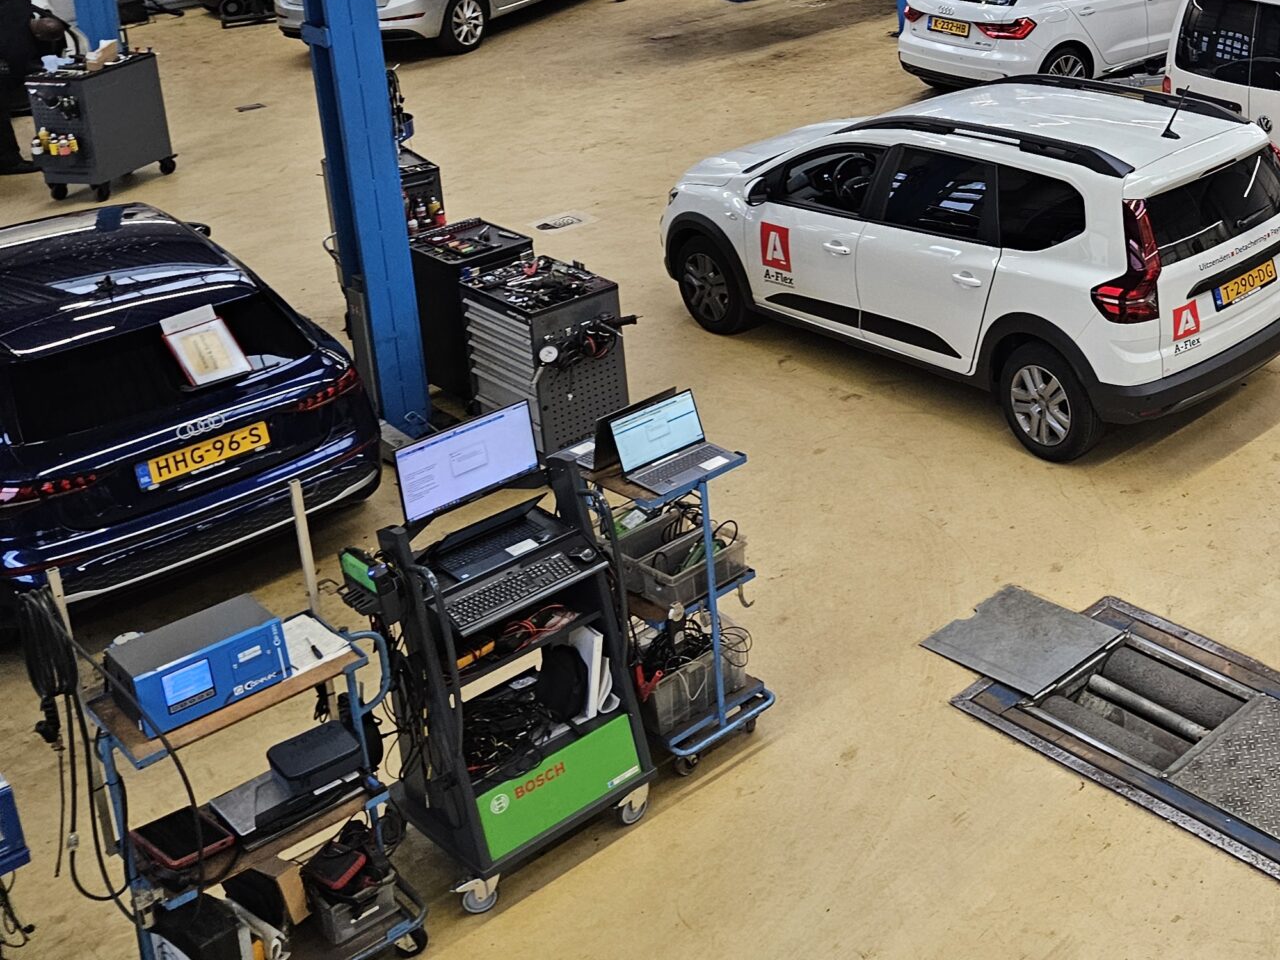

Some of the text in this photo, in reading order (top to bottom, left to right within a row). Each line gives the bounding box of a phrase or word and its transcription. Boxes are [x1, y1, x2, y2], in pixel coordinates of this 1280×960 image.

[933, 19, 967, 33] K-232-HB
[764, 269, 794, 285] A-Flex
[1222, 263, 1274, 301] T-290-DG
[1174, 338, 1201, 354] A-Flex
[155, 427, 262, 477] HHG-96-S
[514, 761, 566, 800] BOSCH
